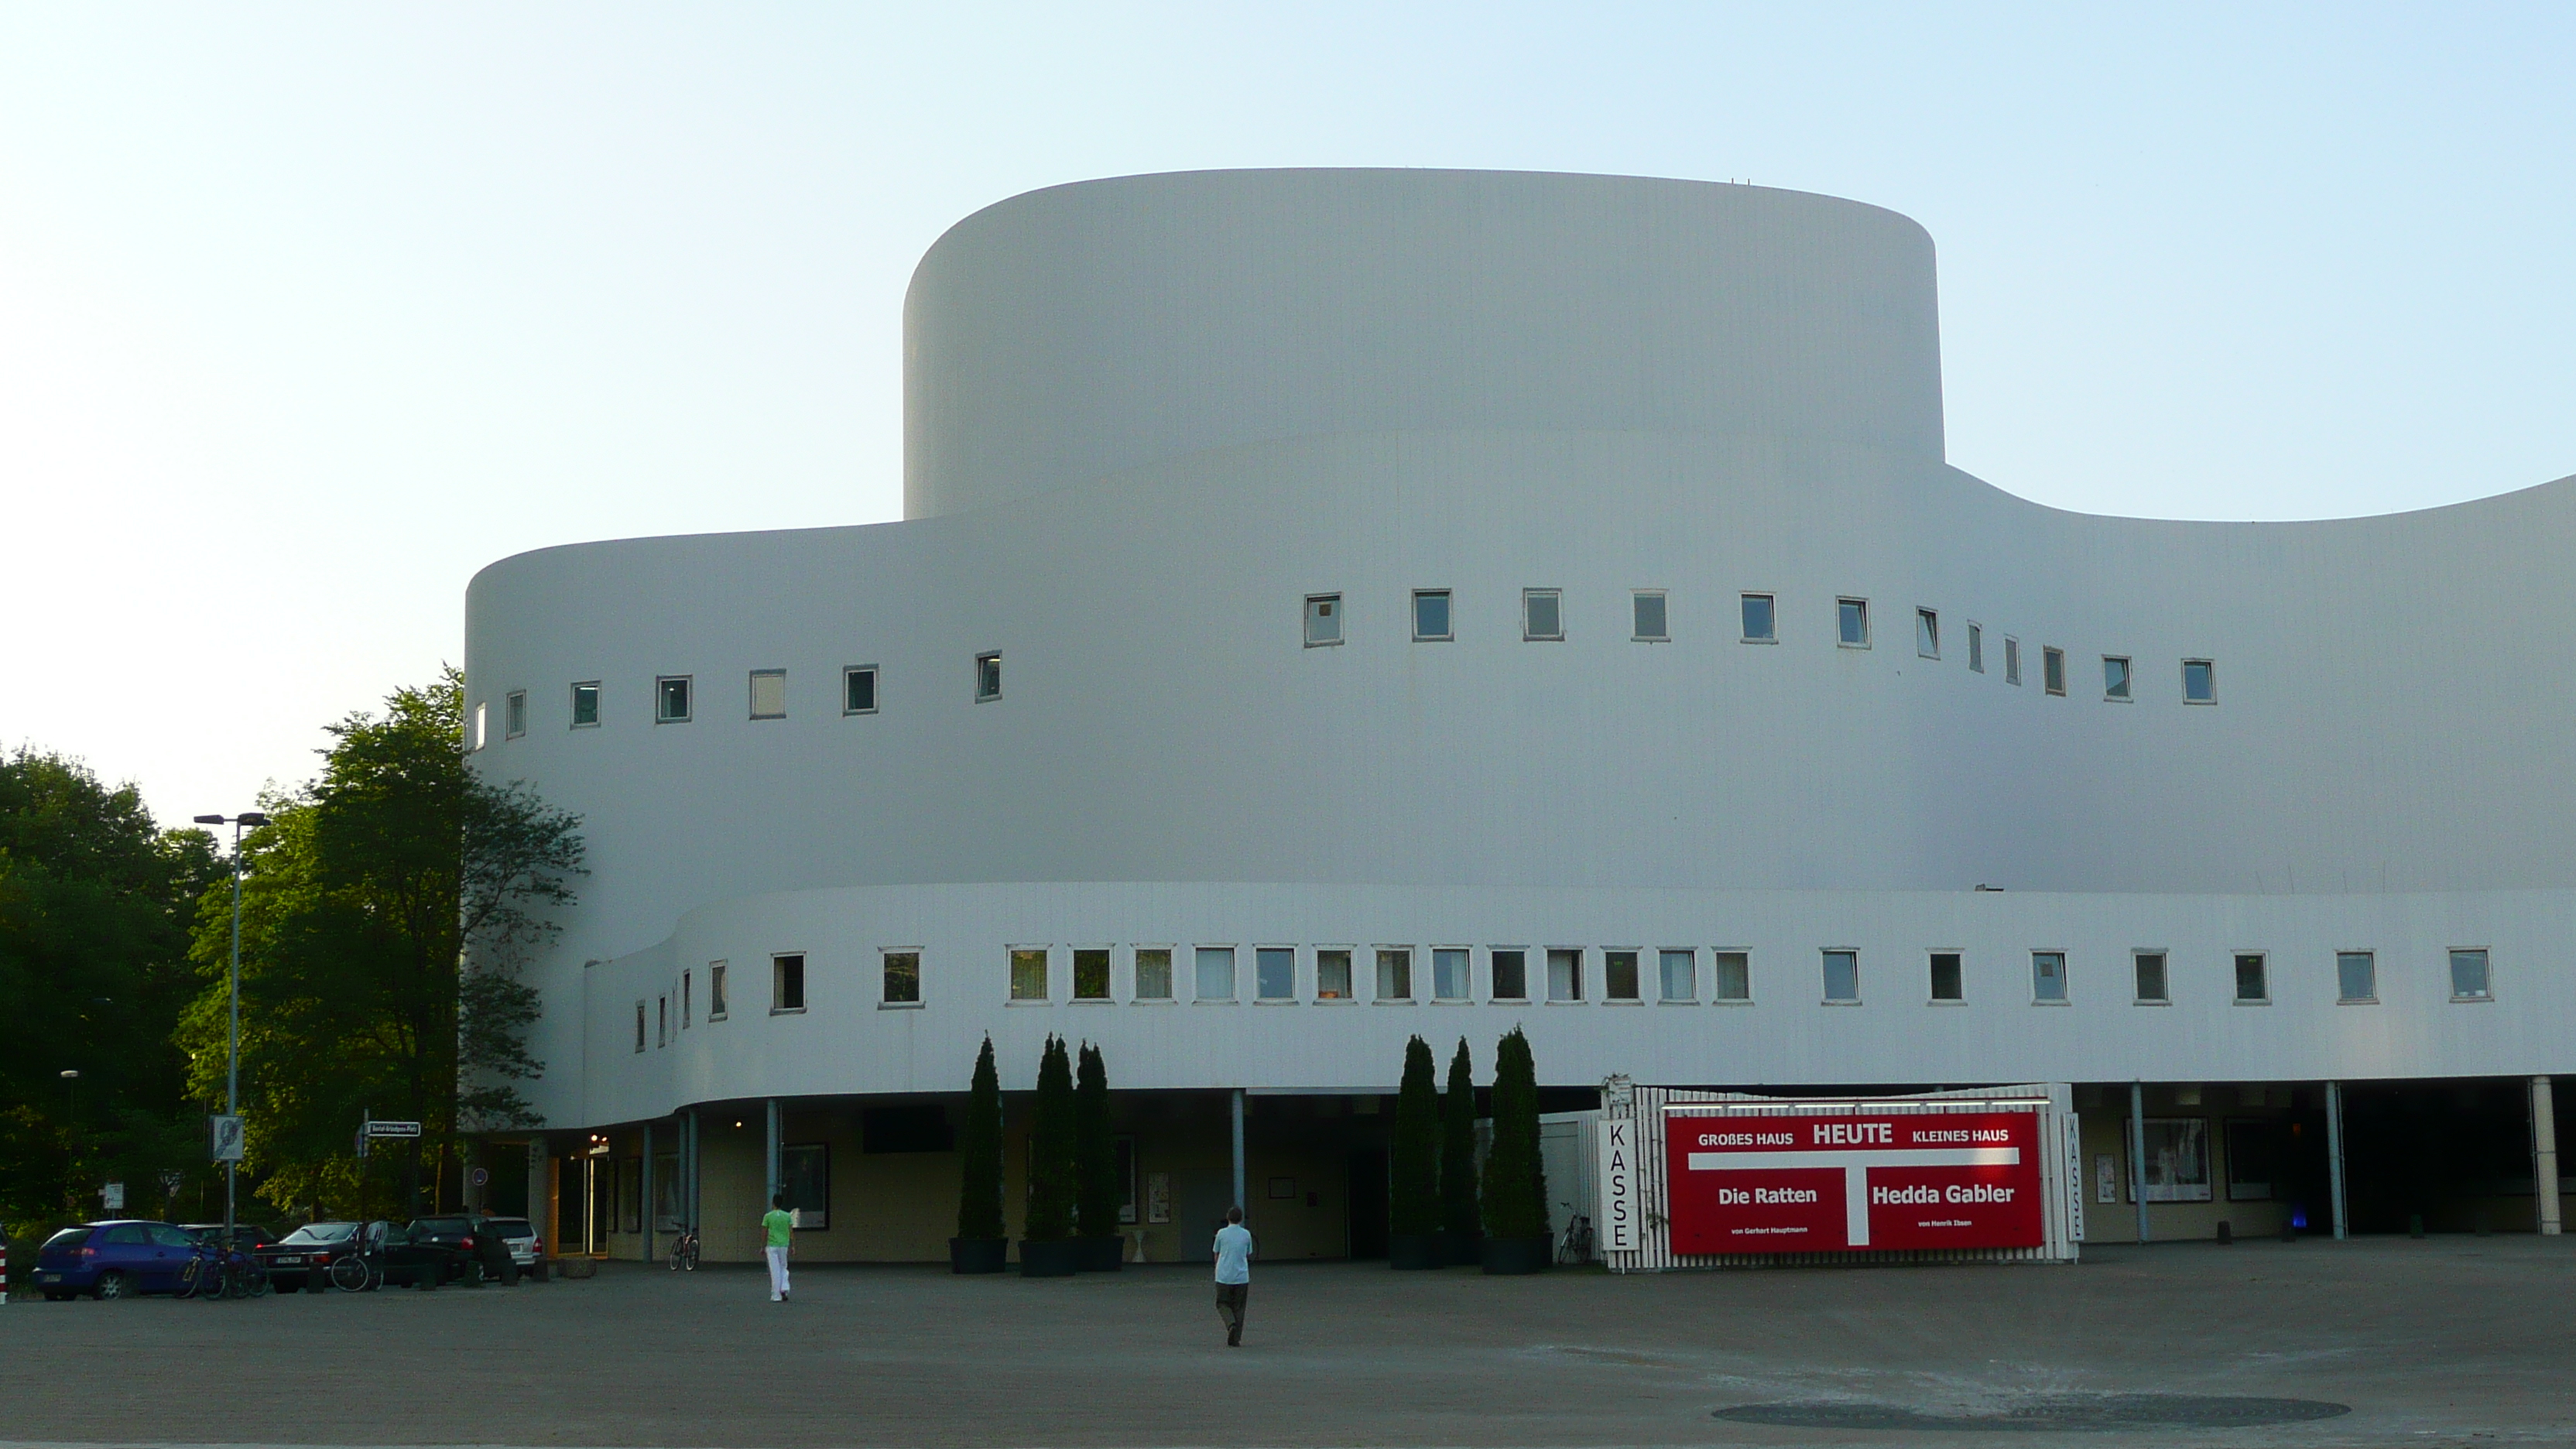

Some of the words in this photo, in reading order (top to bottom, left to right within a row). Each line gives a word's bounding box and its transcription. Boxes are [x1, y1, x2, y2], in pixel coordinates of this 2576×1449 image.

[1698, 1134, 1753, 1146] GROßES
[1756, 1133, 1793, 1145] HAUS
[1814, 1123, 1893, 1144] HEUTE
[1913, 1131, 1969, 1142] KLEINES
[1972, 1129, 2009, 1142] HAUS
[1610, 1125, 1627, 1246] KASSE
[2069, 1118, 2081, 1237] KASSE
[1718, 1188, 1750, 1204] Die
[1755, 1187, 1817, 1204] Ratten
[1872, 1185, 1940, 1204] Hedda
[1945, 1184, 2014, 1203] Gabler
[1771, 1226, 1807, 1235] Hauptmann
